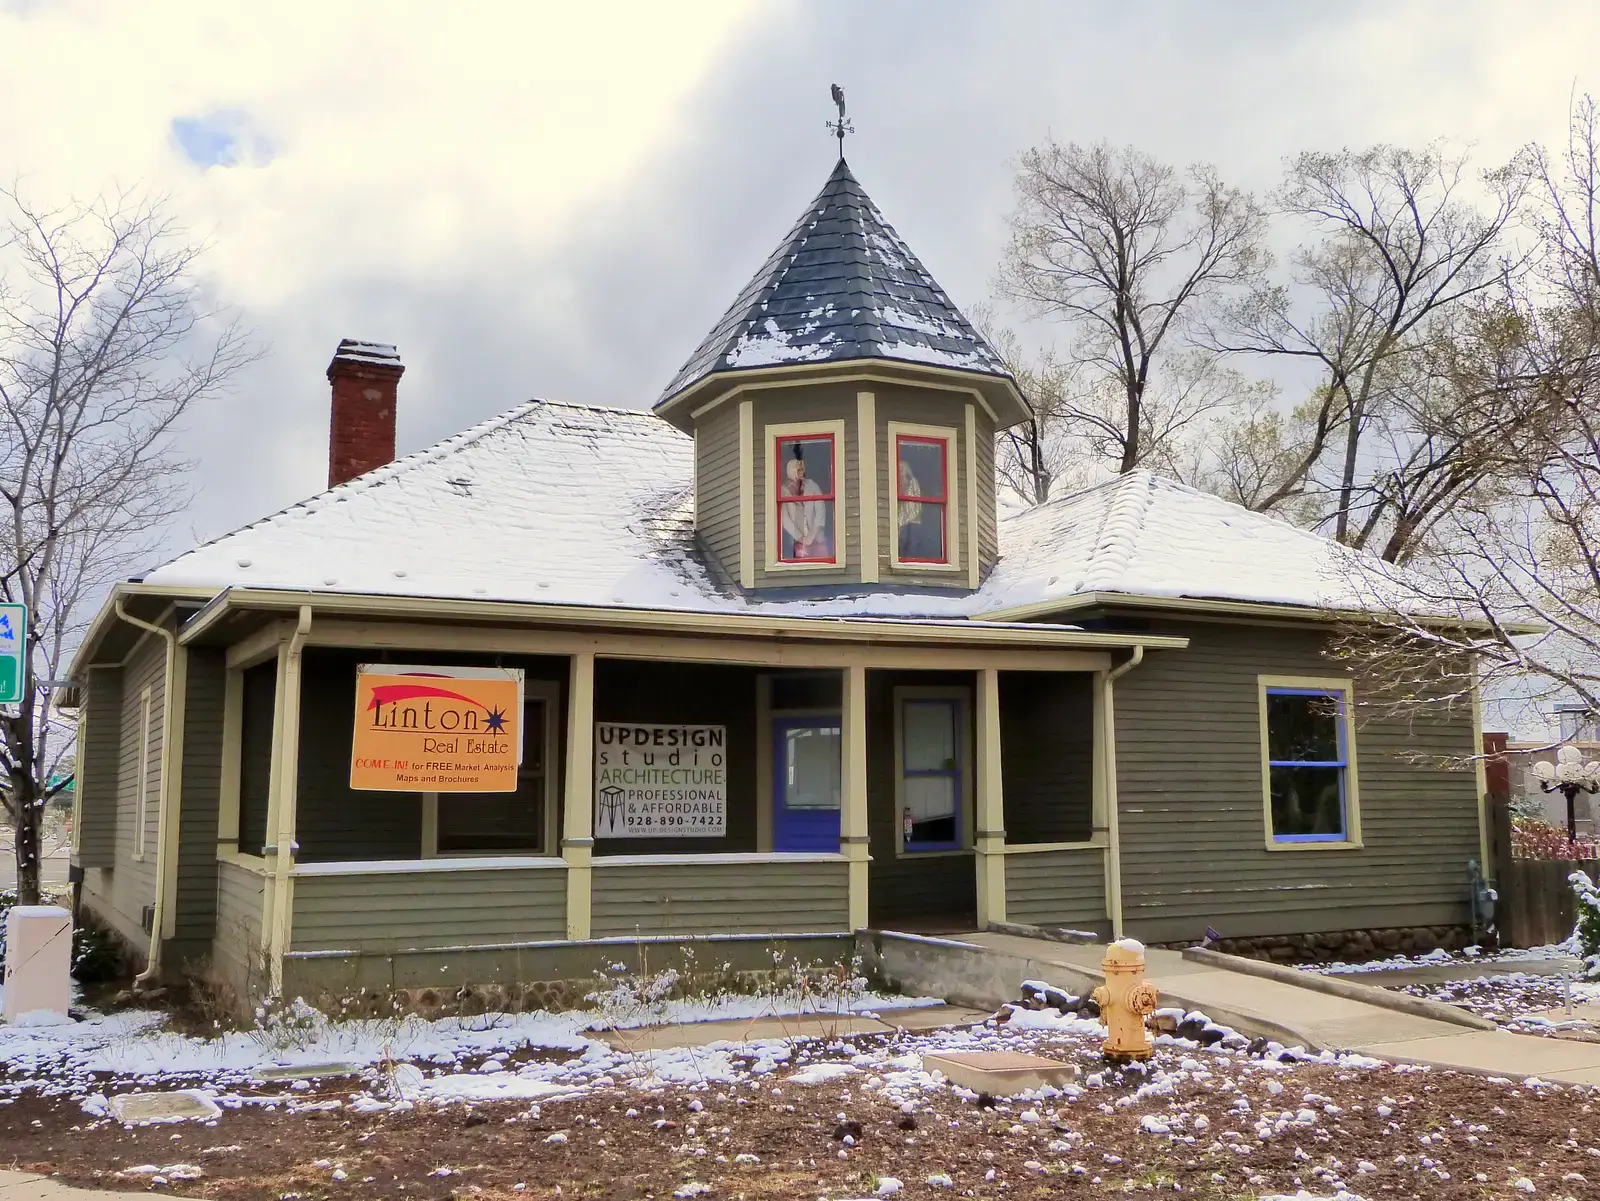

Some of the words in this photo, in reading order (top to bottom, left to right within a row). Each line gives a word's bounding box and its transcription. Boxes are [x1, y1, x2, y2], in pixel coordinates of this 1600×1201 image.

[372, 699, 479, 730] Linton
[423, 737, 459, 754] Real
[466, 738, 509, 754] Estate
[600, 747, 723, 767] studio
[355, 758, 391, 769] COME
[394, 759, 409, 770] IN!
[412, 762, 424, 771] for
[426, 762, 453, 771] FREE
[454, 763, 481, 771] Market
[483, 763, 515, 772] Analysis
[396, 774, 419, 784] Maps
[421, 775, 437, 783] and
[438, 775, 479, 784] Brochures
[600, 768, 723, 785] ARCHITECTURE
[628, 789, 723, 801] PROFESSIONAL
[628, 803, 637, 814] &
[641, 802, 723, 814] AFFORDABLE
[628, 816, 723, 826] 928-890-7422
